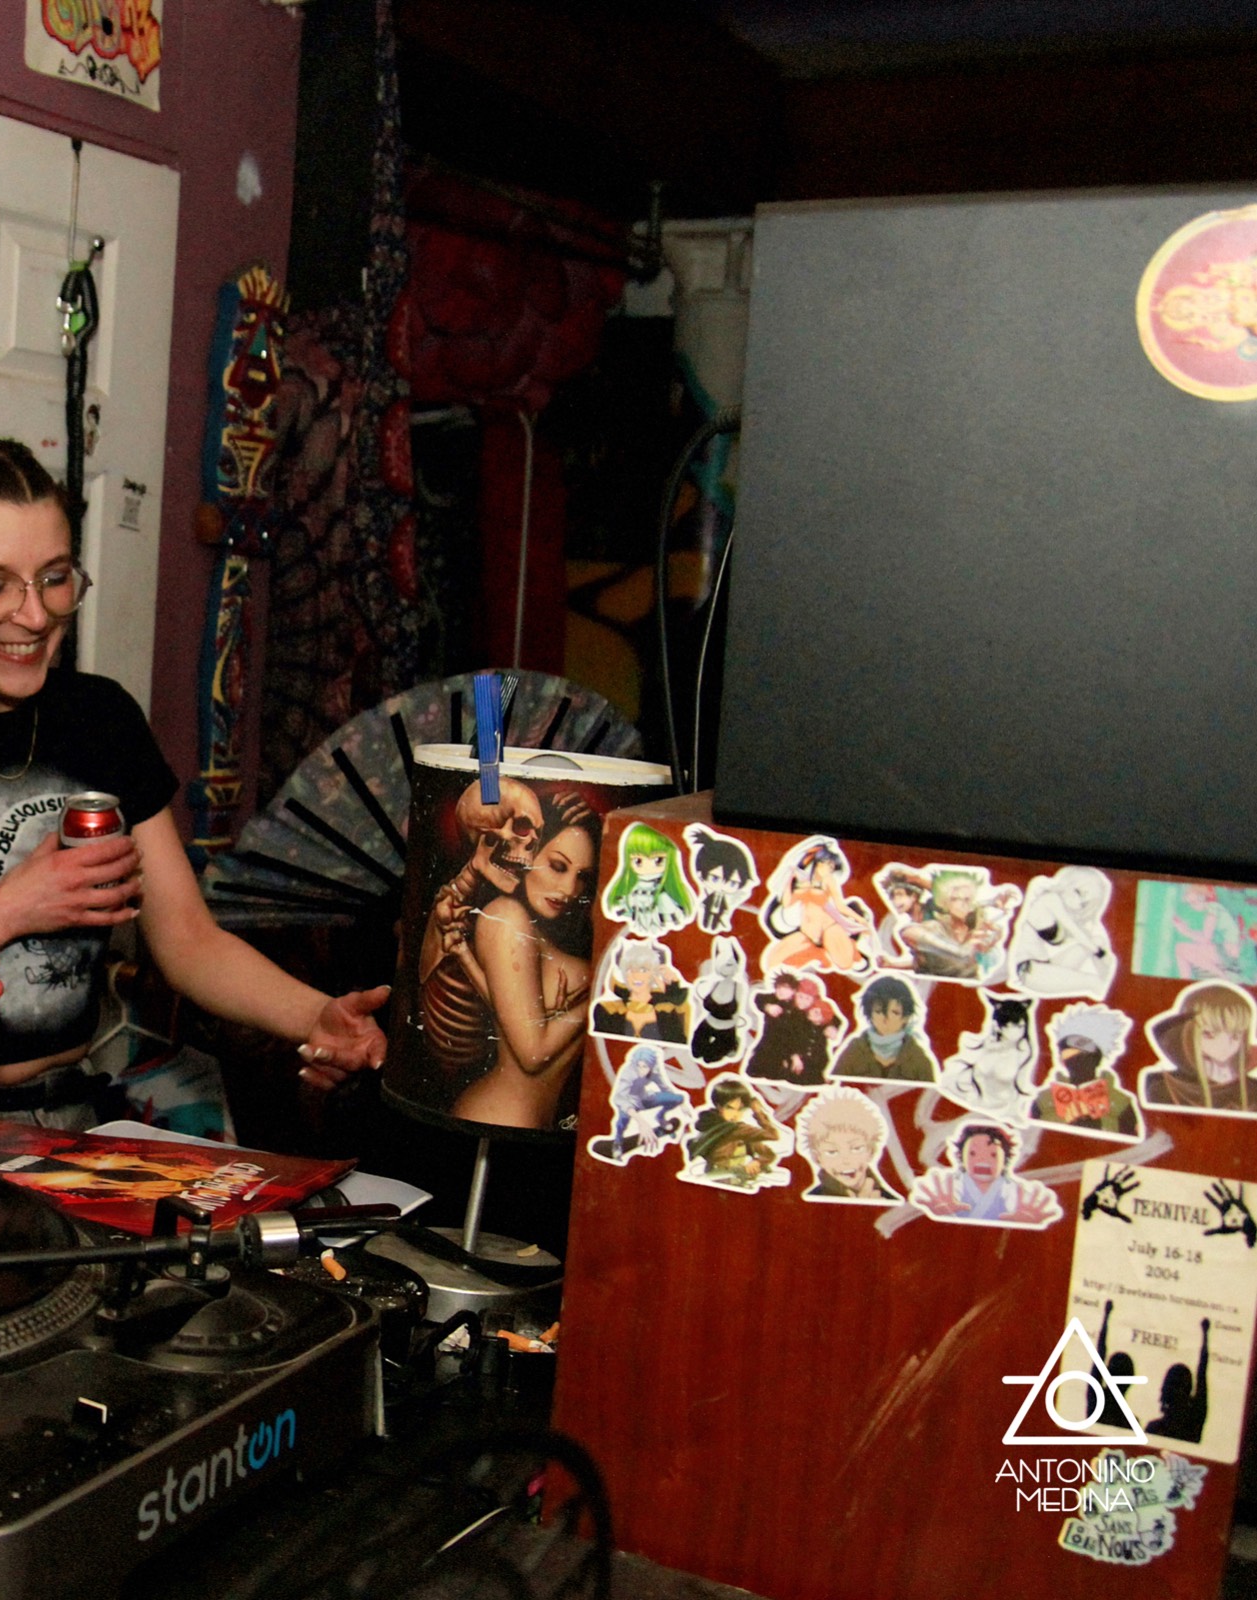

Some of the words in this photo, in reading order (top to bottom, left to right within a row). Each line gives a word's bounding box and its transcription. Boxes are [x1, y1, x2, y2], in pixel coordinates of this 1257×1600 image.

[1132, 1198, 1210, 1225] TEKNIVAL
[1127, 1240, 1157, 1258] July
[1164, 1246, 1203, 1263] 16-18
[1145, 1265, 1180, 1281] 2004
[1130, 1328, 1178, 1350] FREE!
[137, 1408, 296, 1541] stanton
